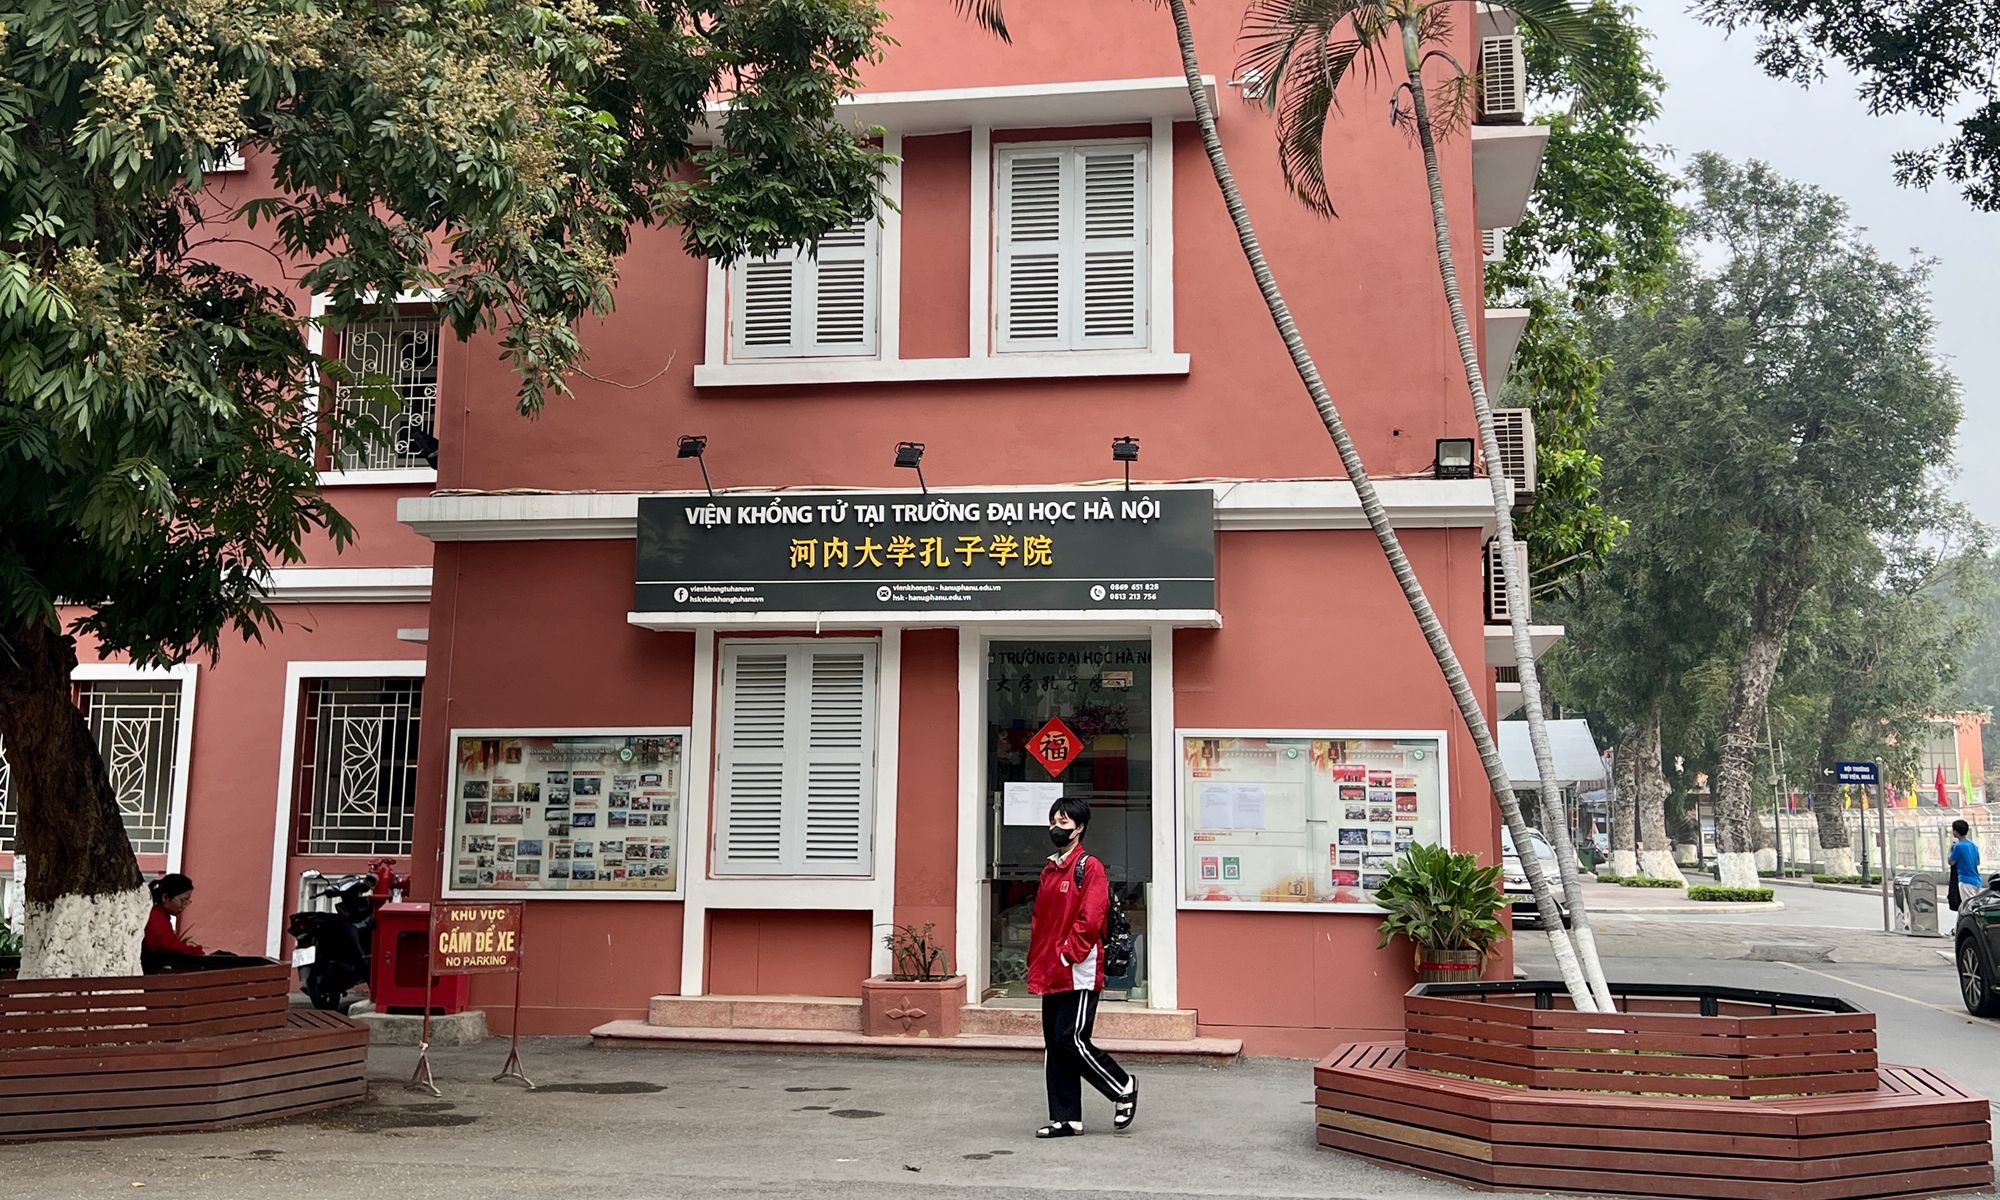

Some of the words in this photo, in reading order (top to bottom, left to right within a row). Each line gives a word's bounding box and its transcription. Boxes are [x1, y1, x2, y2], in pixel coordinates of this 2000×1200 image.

[685, 503, 731, 529] VIỆN
[737, 497, 813, 525] KHỔNG
[817, 499, 849, 523] TỬ
[854, 504, 885, 527] TẠI
[891, 498, 980, 523] TRƯỜNG
[987, 502, 1023, 526] ĐẠI
[1029, 501, 1076, 525] HỌC
[1084, 496, 1114, 521] HÀ
[1121, 495, 1161, 524] NỘI
[789, 534, 1053, 569] 河内大学孔子学院
[689, 585, 755, 594] vienkhongtuhanuvn
[892, 584, 935, 593] vienkhongtu
[999, 648, 1055, 665] TRƯỜNG
[1058, 651, 1080, 667] ĐẠI
[1084, 651, 1113, 667] HỌC
[1116, 648, 1135, 664] HÀ
[1040, 732, 1068, 760] 福
[1288, 876, 1307, 897] 道
[451, 910, 477, 921] KHU
[480, 909, 506, 923] VỰC
[439, 926, 472, 954] CẤM
[475, 924, 496, 953] ĐỂ
[497, 931, 515, 952] XE
[445, 957, 461, 967] NO
[463, 955, 507, 966] PARKING
